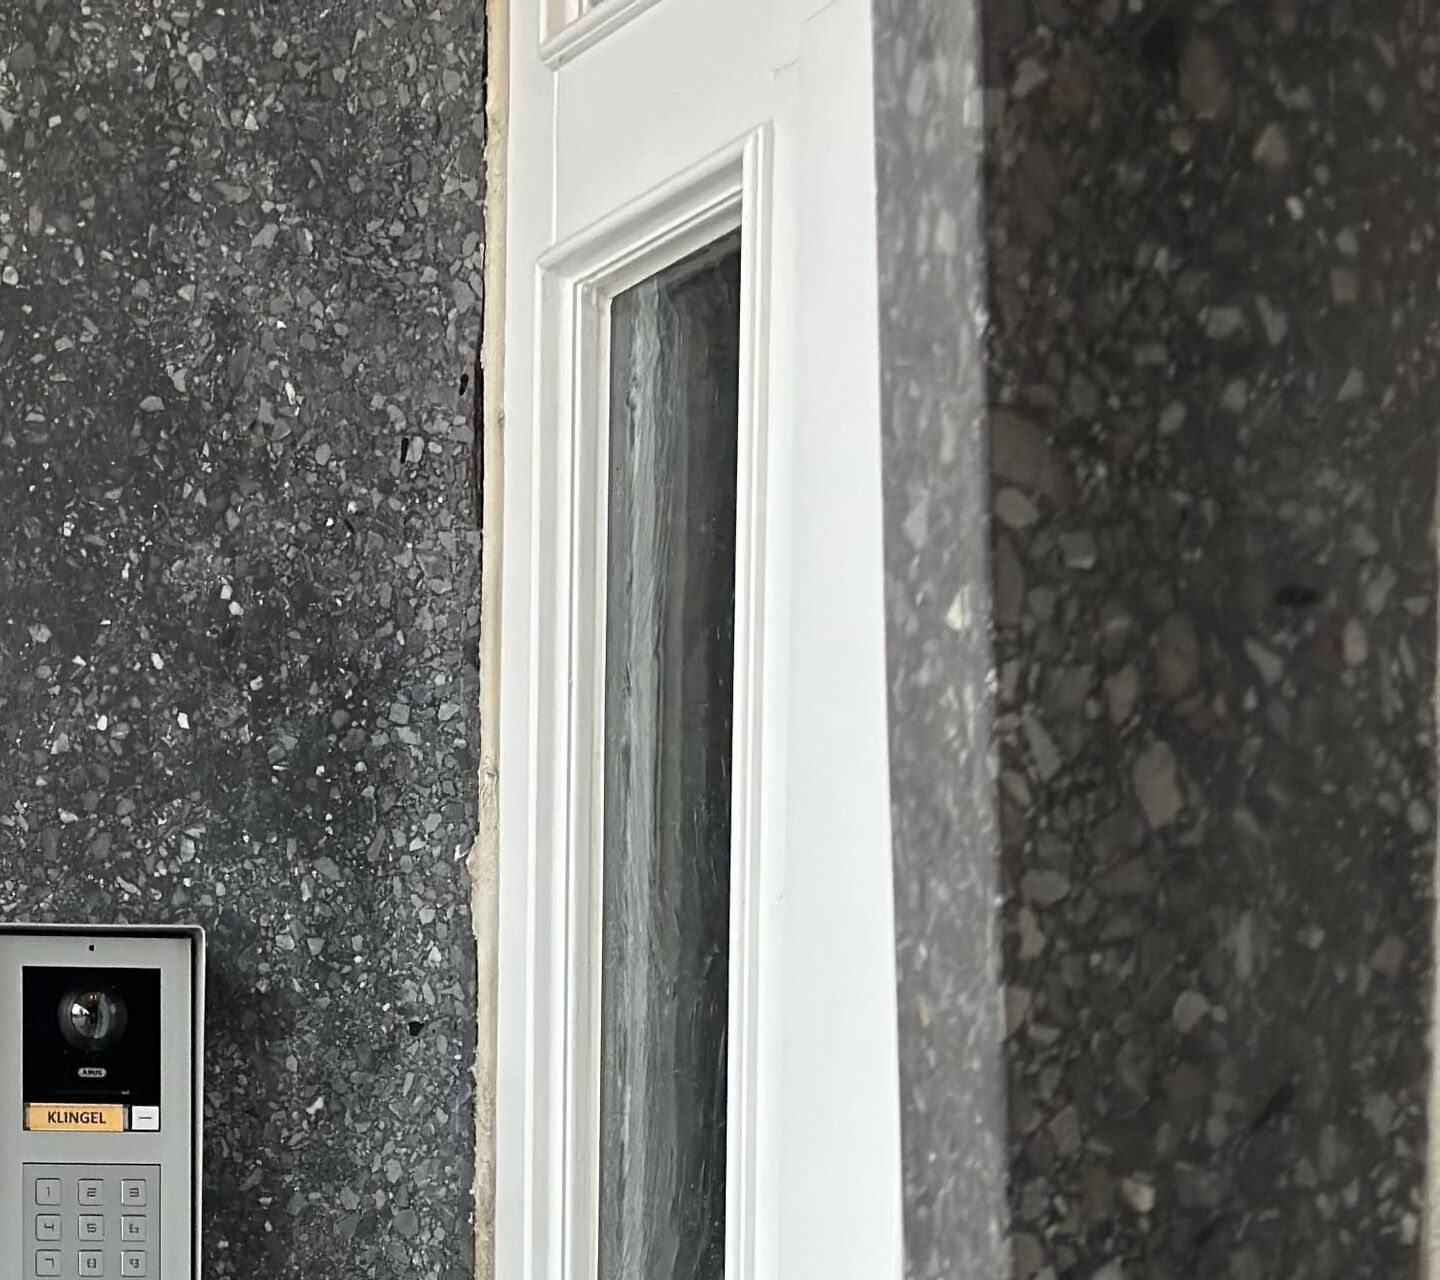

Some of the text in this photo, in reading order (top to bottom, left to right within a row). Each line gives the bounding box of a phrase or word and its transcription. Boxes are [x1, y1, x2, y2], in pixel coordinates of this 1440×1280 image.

[47, 1111, 106, 1124] KLINGEL
[87, 1187, 97, 1197] 2
[129, 1187, 140, 1198] 3
[86, 1223, 97, 1233] 5
